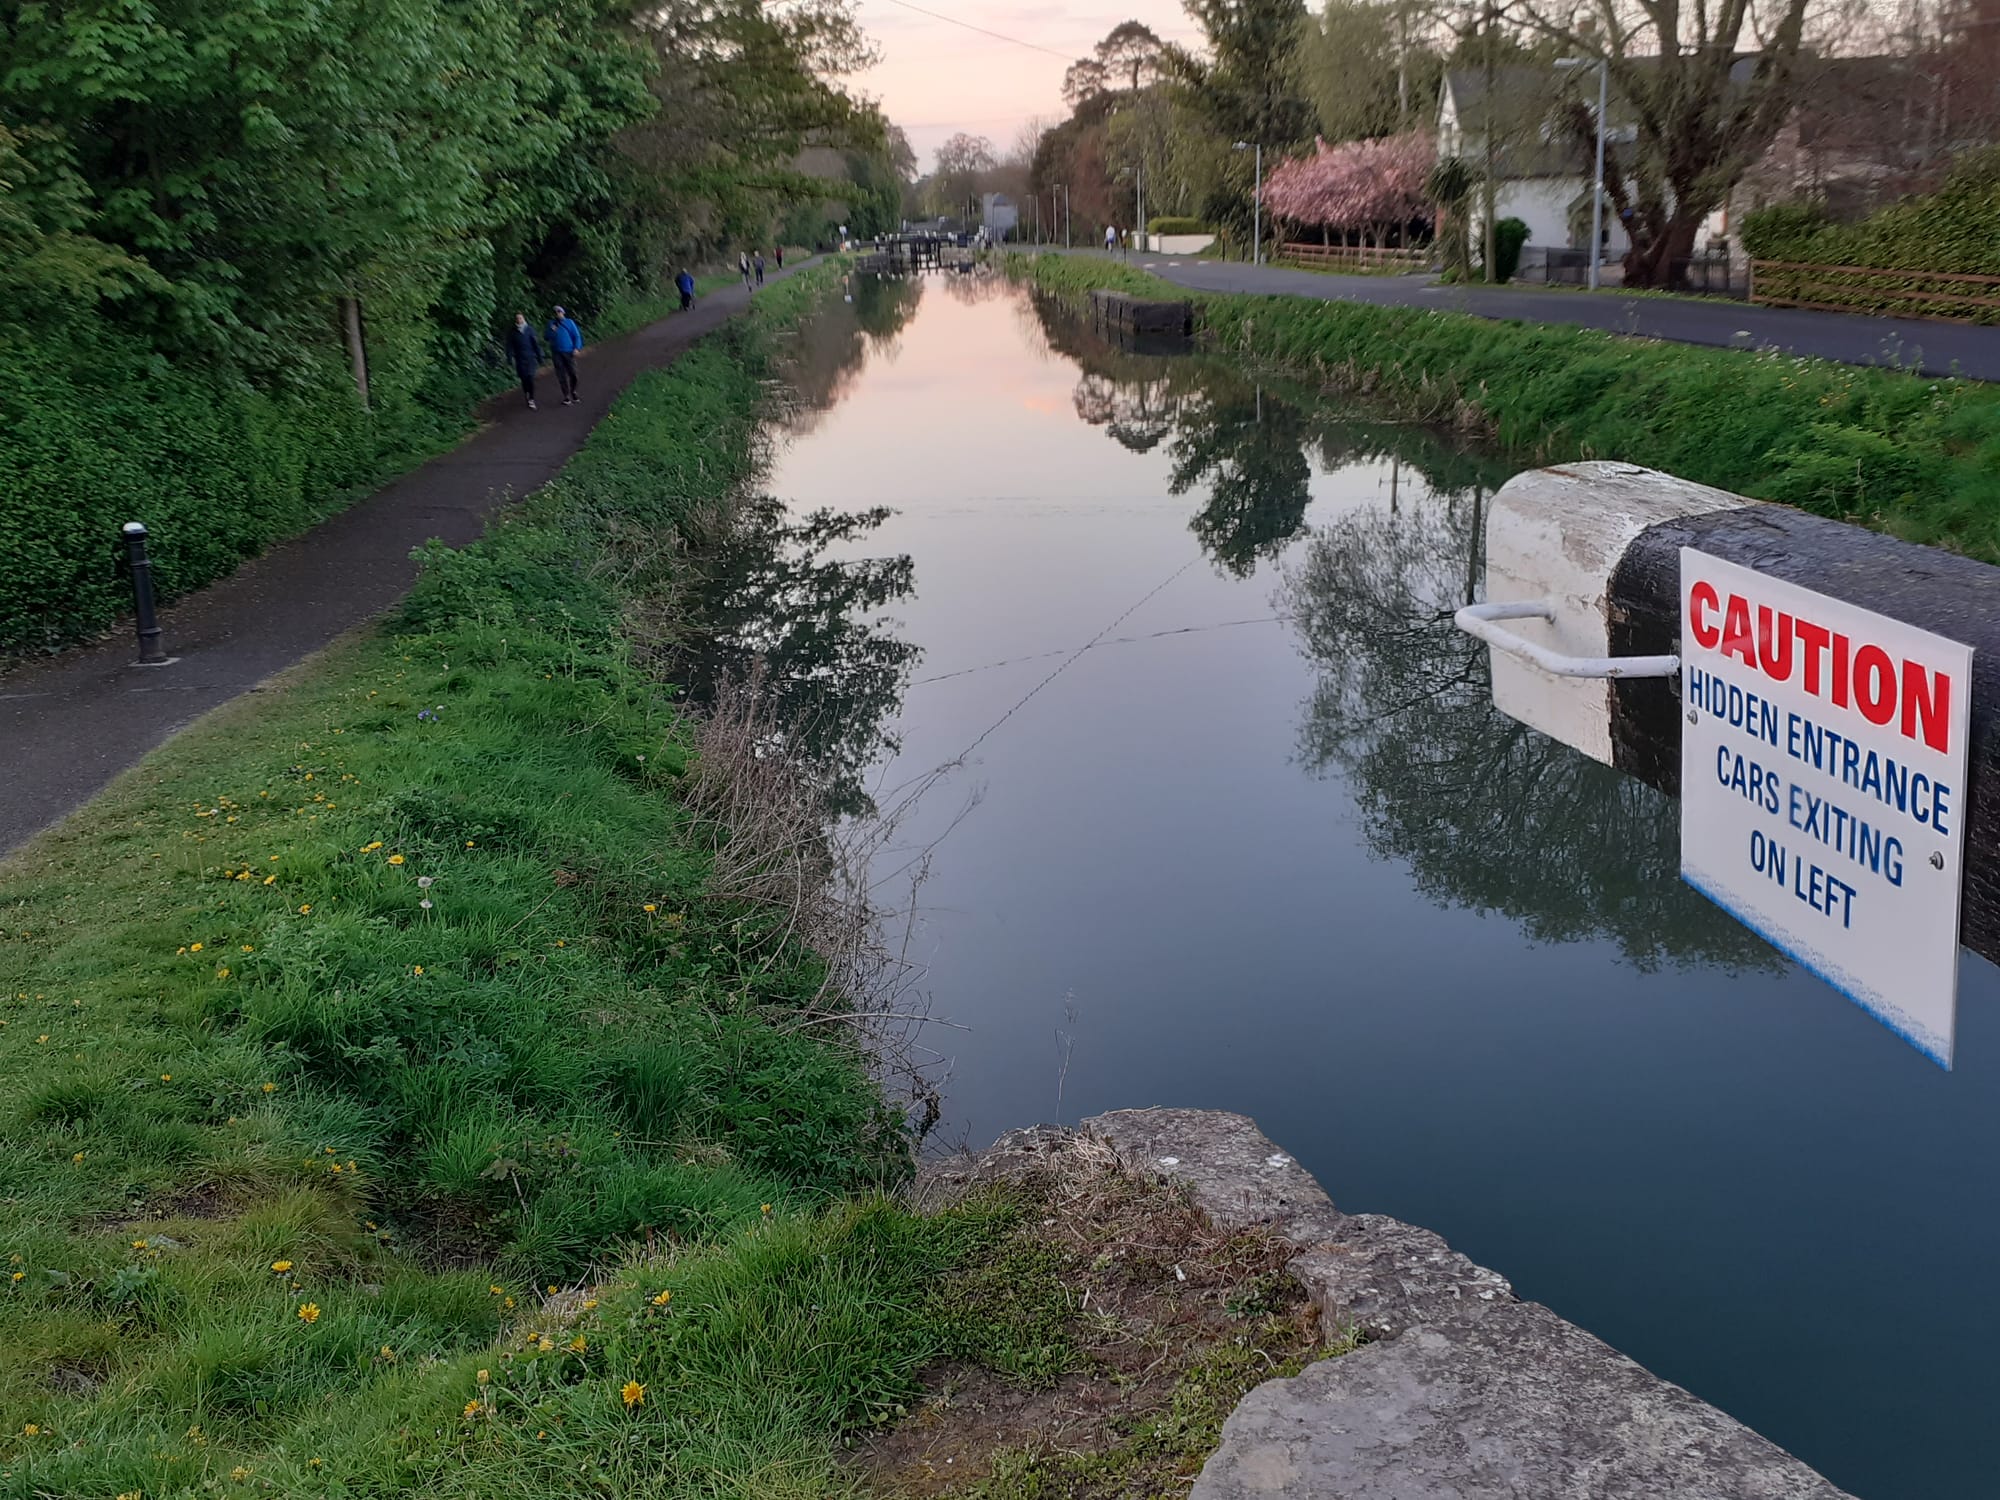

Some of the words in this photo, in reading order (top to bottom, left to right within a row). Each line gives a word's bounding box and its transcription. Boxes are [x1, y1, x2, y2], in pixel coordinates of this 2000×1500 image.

[1689, 580, 1951, 755] CAUTION
[1689, 665, 1778, 747] HIDDEN
[1787, 713, 1951, 836] ENTRANCE
[1716, 745, 1780, 815] CARS
[1789, 783, 1904, 888] EXITING
[1750, 829, 1786, 887] ON
[1795, 856, 1857, 930] LEFT
